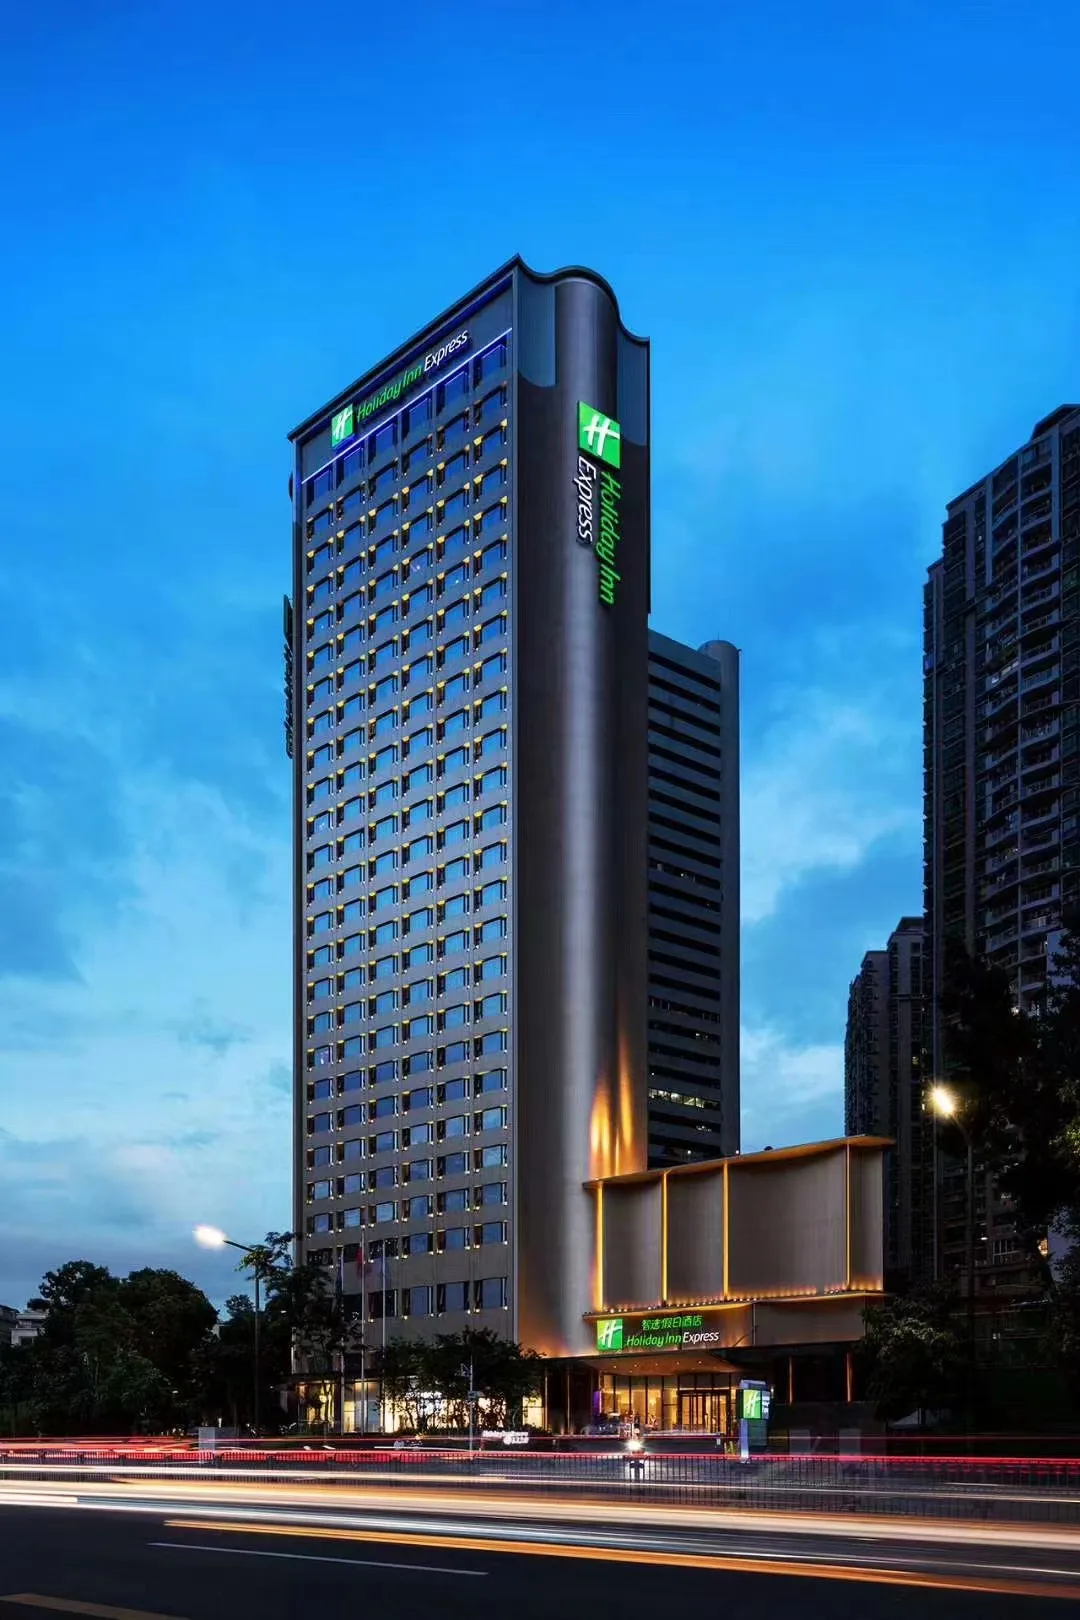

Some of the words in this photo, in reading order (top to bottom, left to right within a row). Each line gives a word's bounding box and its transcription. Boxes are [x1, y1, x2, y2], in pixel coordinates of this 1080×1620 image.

[357, 386, 401, 422] Holiday
[403, 365, 422, 388] Inn
[424, 330, 468, 371] Express
[573, 456, 596, 541] Express
[596, 471, 621, 564] Holiday
[600, 563, 621, 605] Inn
[626, 1335, 664, 1347] Holiday
[665, 1332, 682, 1344] Inn
[682, 1331, 720, 1344] Express
